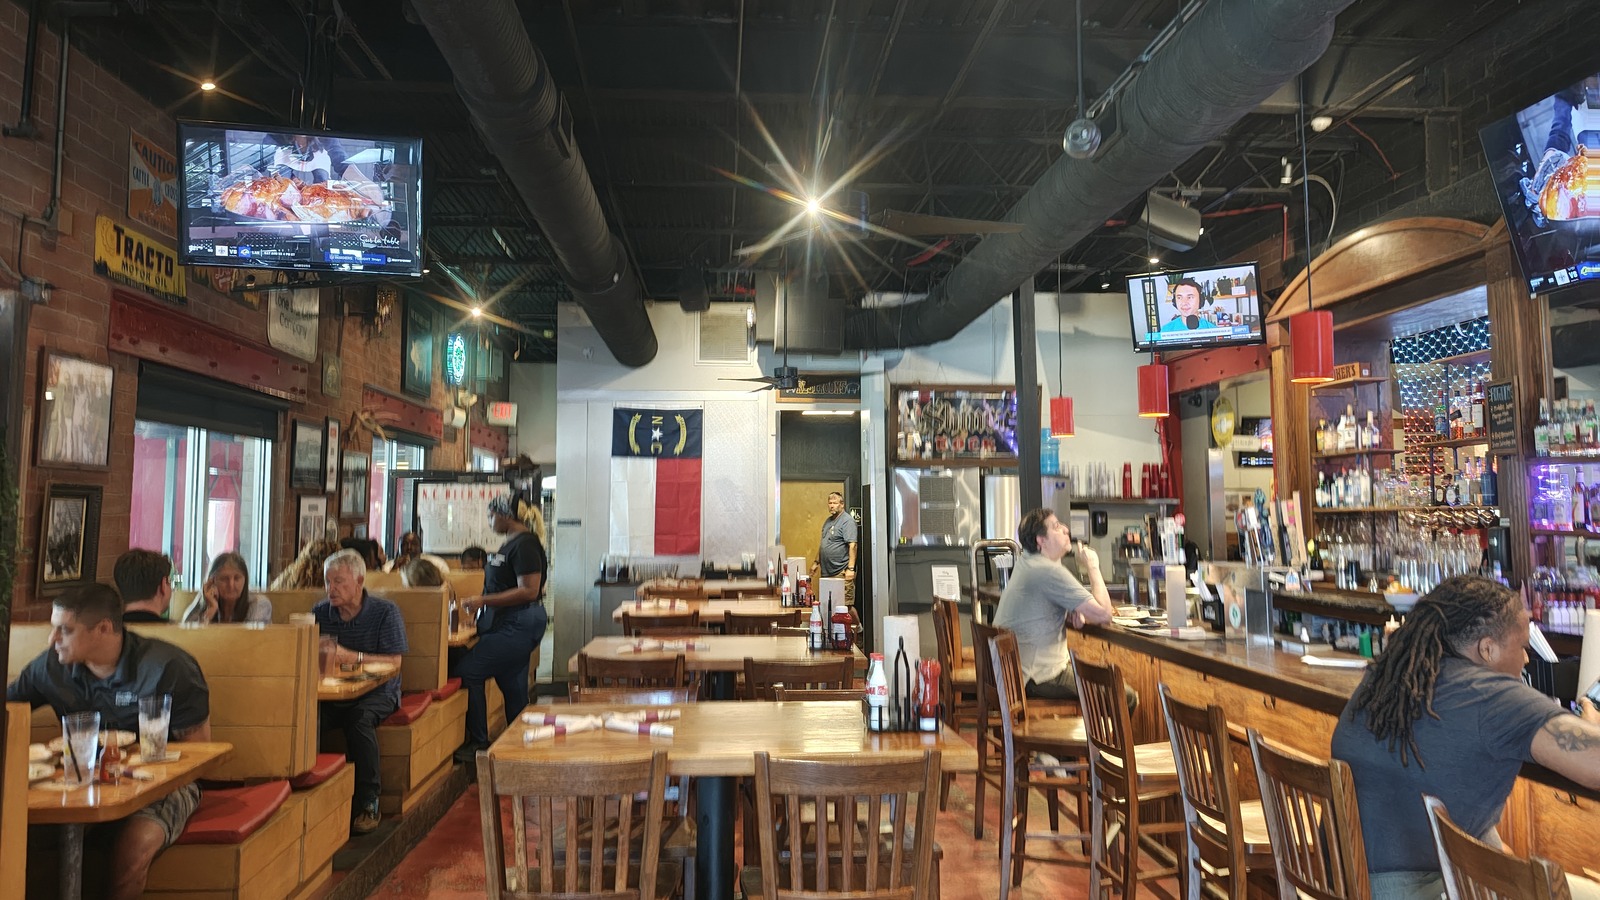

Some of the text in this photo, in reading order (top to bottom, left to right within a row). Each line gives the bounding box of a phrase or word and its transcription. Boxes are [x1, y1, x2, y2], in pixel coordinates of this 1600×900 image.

[113, 223, 175, 279] TRACTO
[121, 259, 151, 285] MOTOR
[154, 275, 168, 290] OIL
[493, 401, 513, 418] EXIT
[651, 415, 664, 425] N
[650, 441, 663, 455] C
